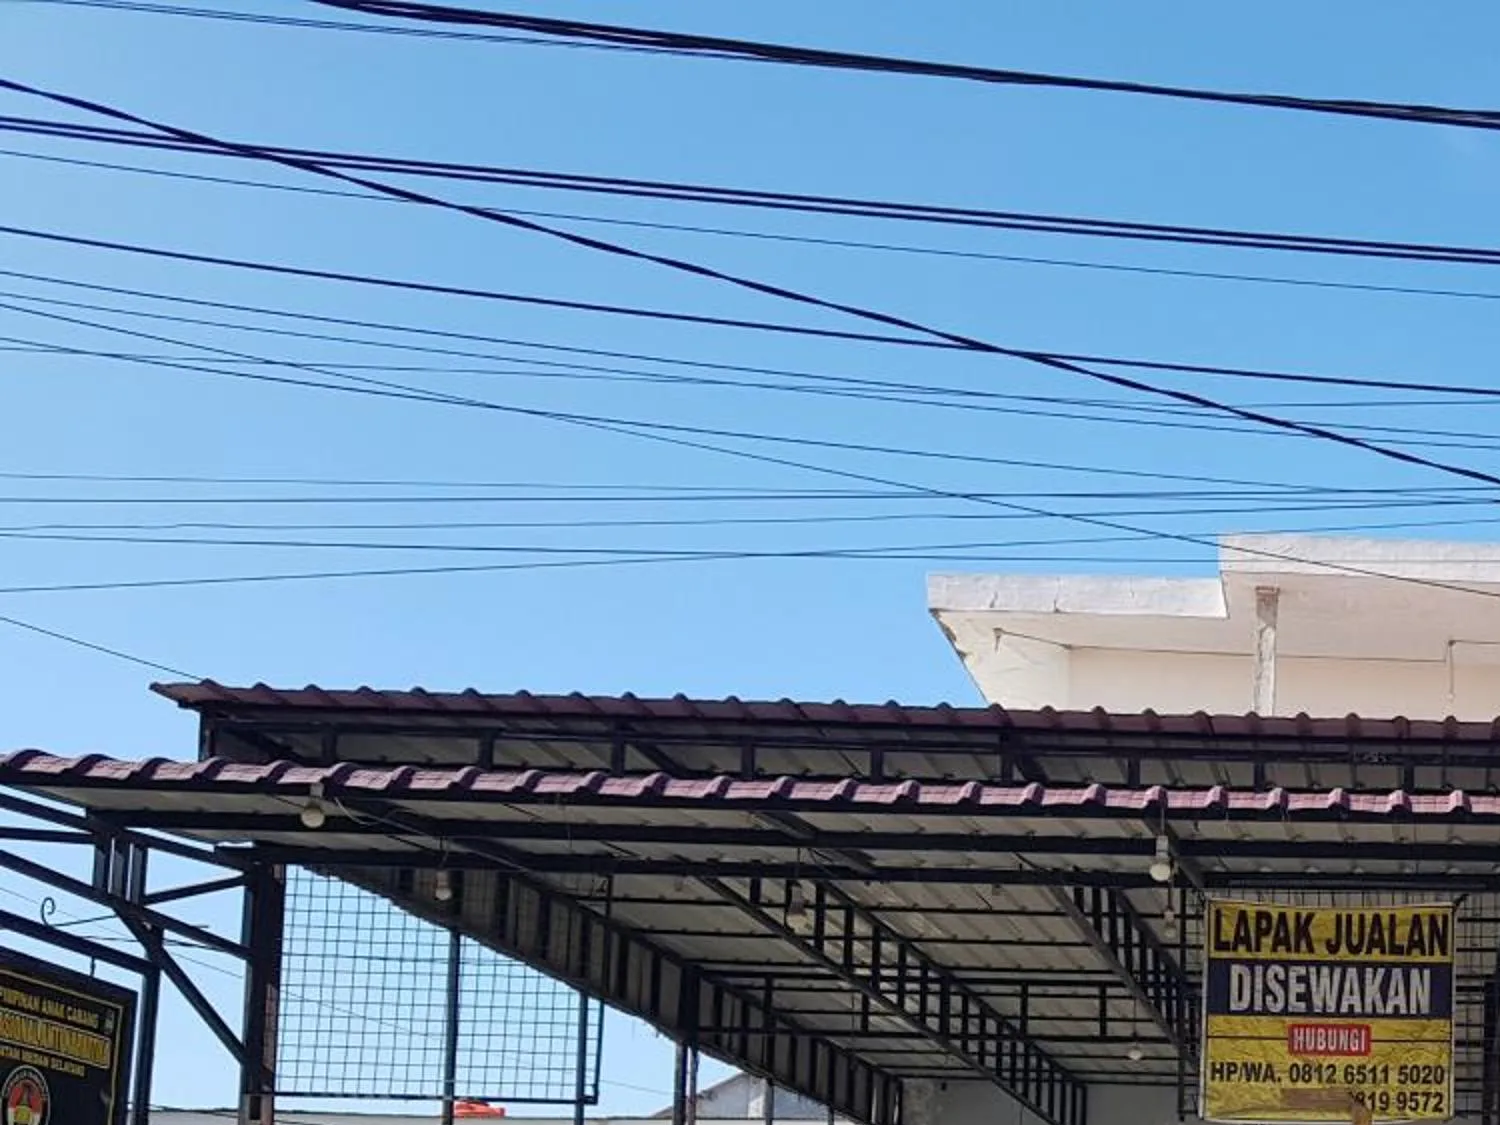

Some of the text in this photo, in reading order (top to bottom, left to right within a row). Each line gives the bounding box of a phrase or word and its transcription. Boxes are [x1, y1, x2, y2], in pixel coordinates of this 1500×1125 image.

[1213, 909, 1449, 956] LAPAK JUALAN
[1229, 963, 1432, 1015] DISEWAKAN
[1293, 1028, 1367, 1052] HUBUNGI
[1210, 1062, 1446, 1085] HP/WA. 0812 6511 5020
[1349, 1090, 1444, 1113] 819 9572
